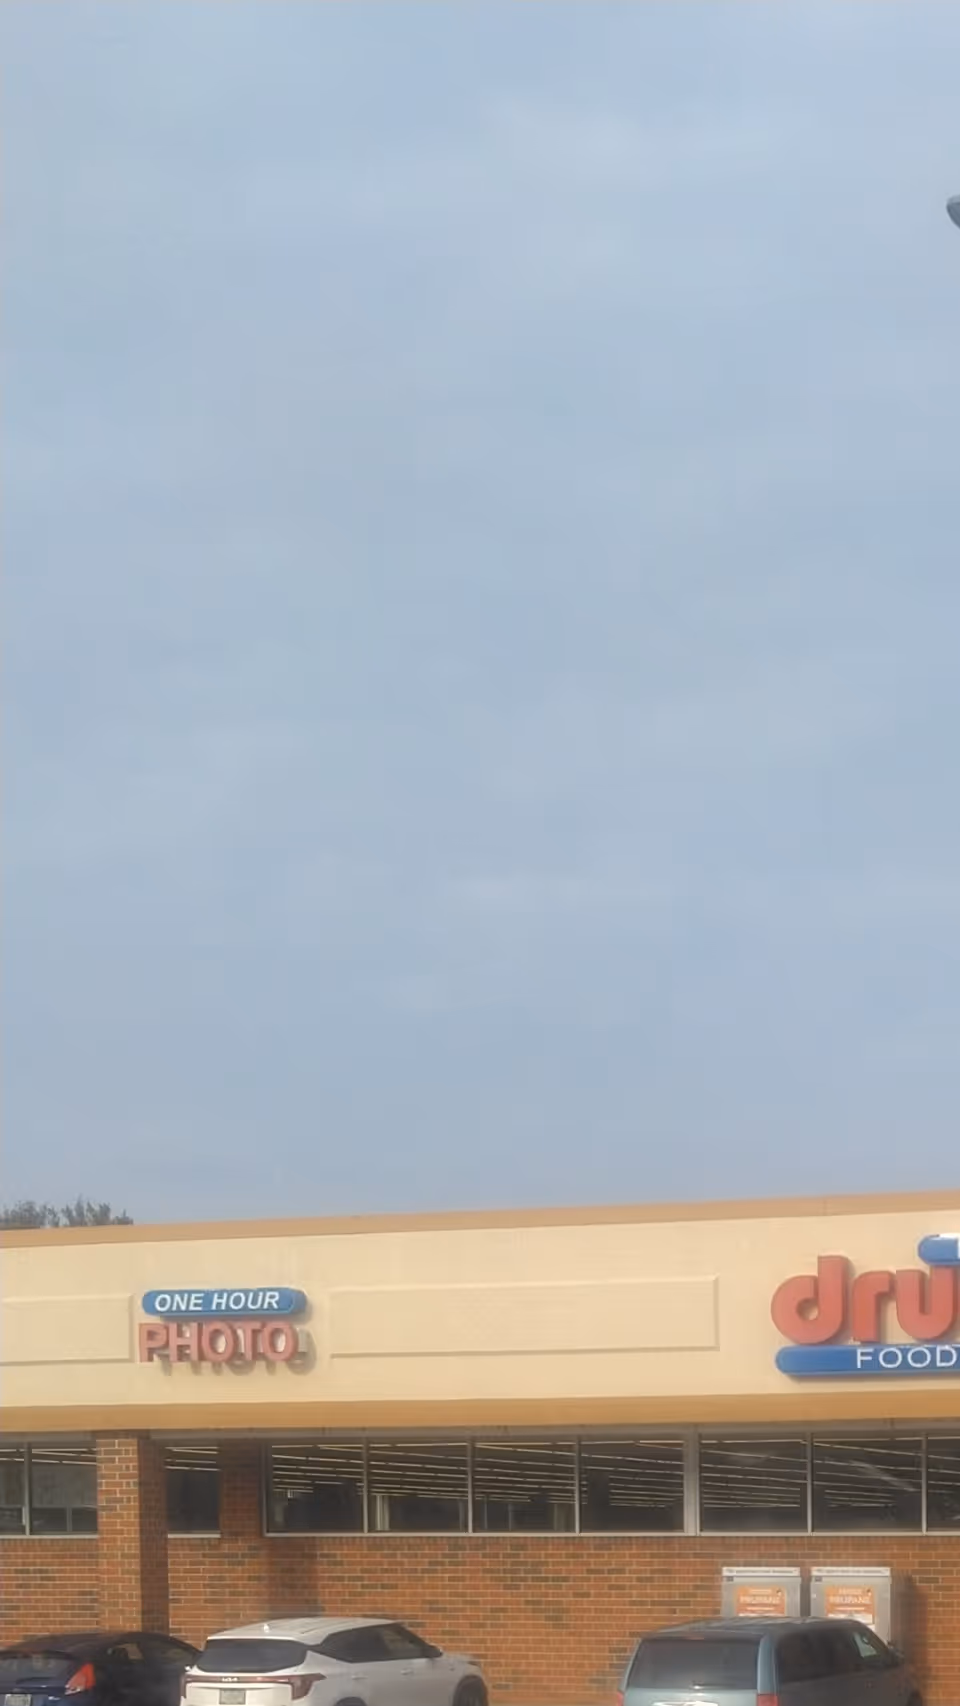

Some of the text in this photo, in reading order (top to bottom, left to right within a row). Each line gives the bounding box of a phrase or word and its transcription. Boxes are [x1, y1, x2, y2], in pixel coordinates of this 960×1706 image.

[155, 1290, 279, 1311] ONE HOUR
[138, 1320, 300, 1363] PHOTO
[855, 1344, 957, 1369] FOOD
